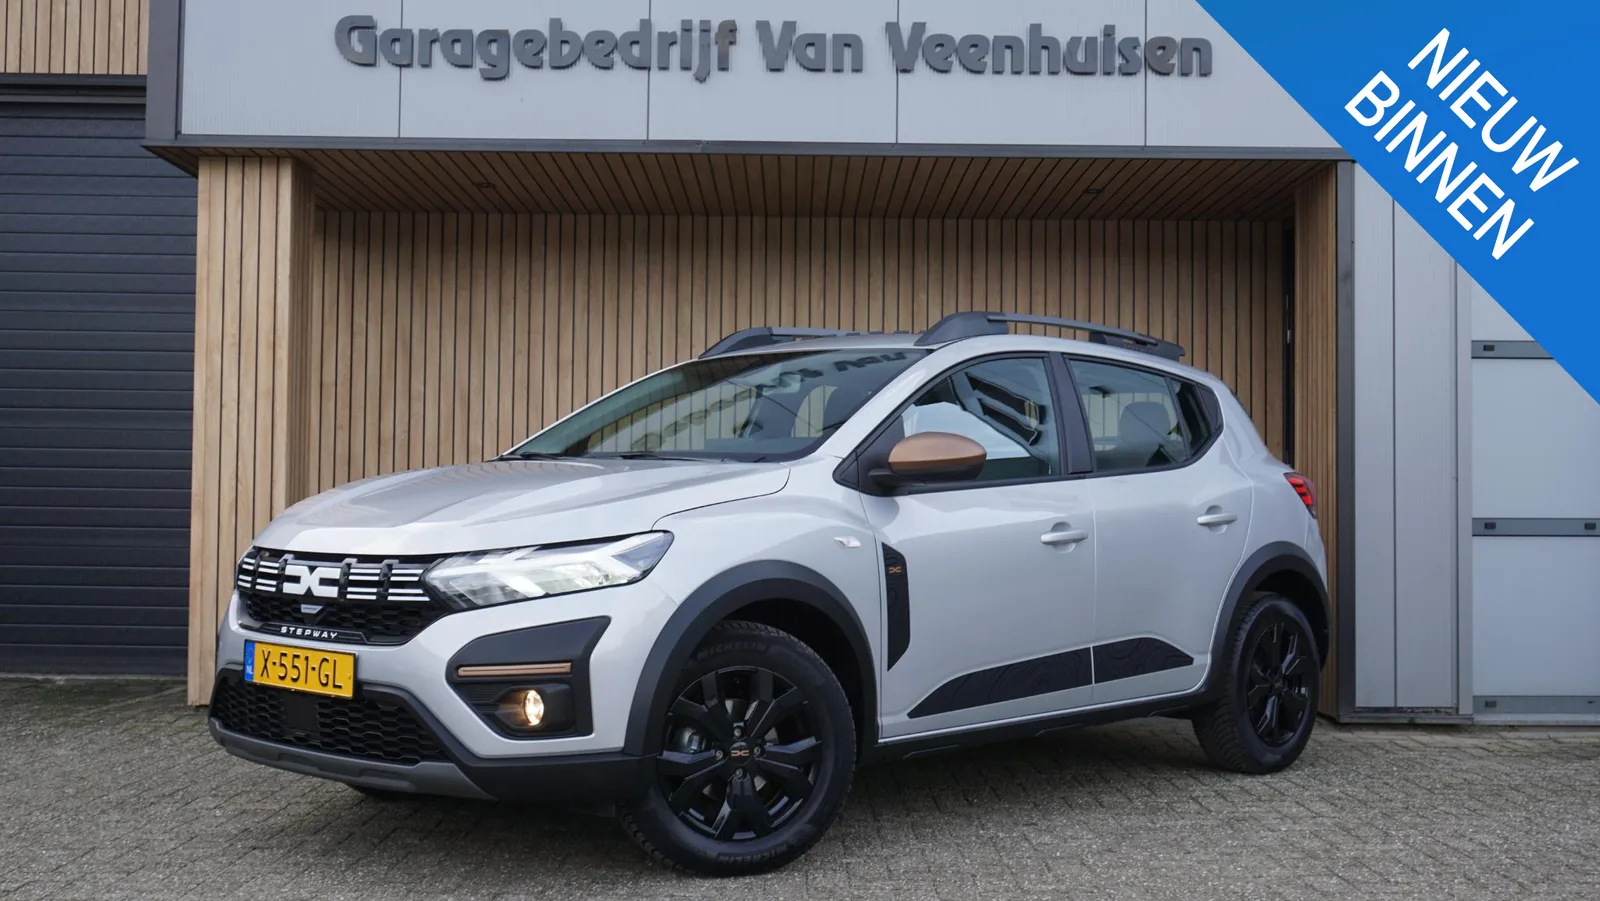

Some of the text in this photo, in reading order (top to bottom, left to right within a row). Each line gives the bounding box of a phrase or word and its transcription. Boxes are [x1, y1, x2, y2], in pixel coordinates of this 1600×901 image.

[334, 15, 1213, 82] Garagebedrijf Van Veenhuisen
[280, 626, 338, 640] STEPWAY
[260, 649, 343, 690] X-551-GL
